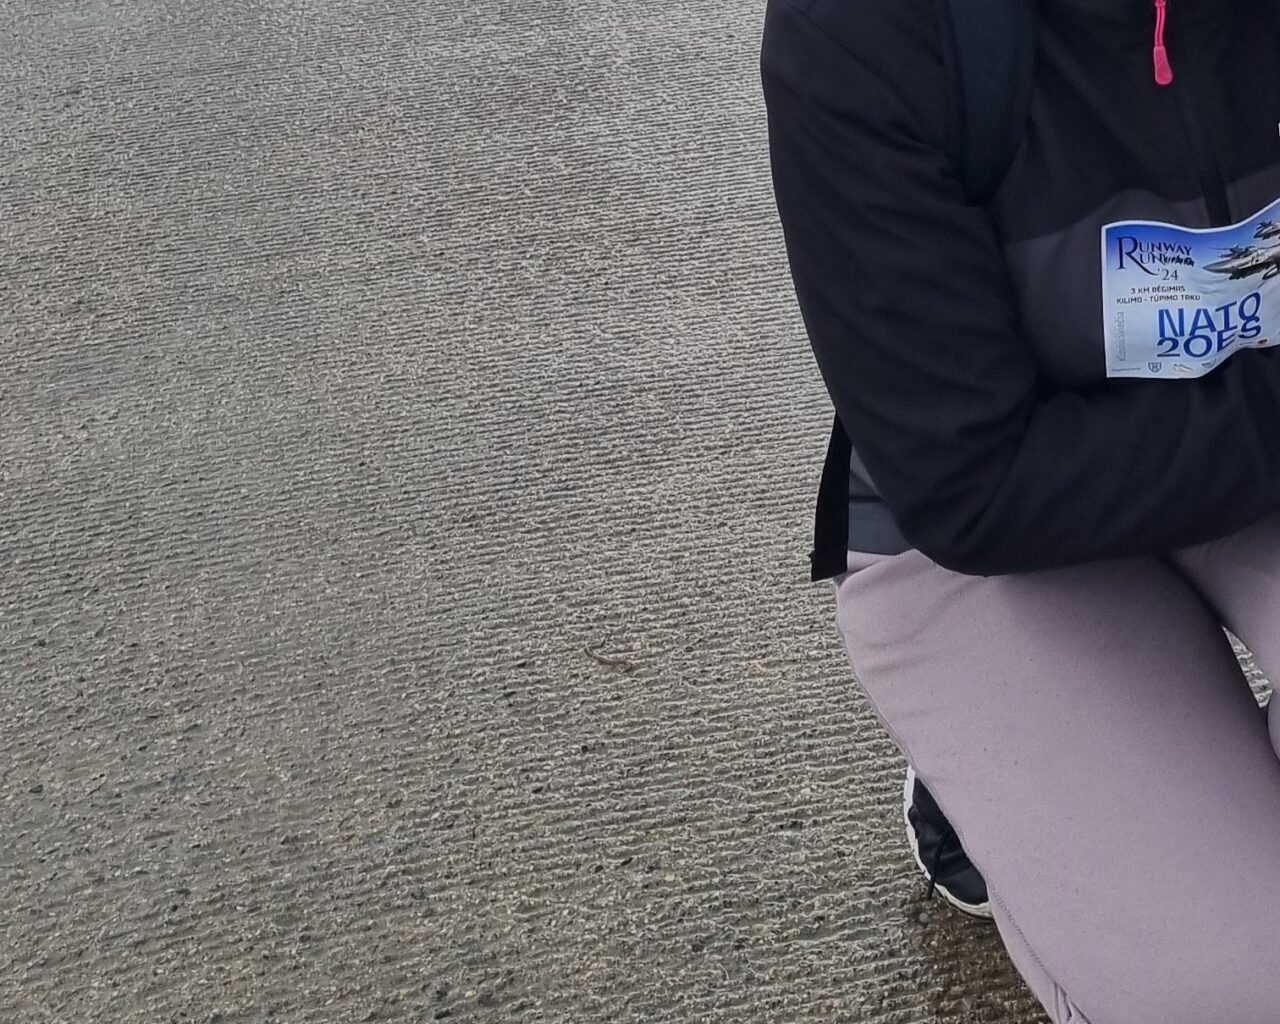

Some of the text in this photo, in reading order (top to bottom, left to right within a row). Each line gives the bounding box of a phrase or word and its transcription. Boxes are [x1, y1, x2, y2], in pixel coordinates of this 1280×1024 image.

[1117, 236, 1193, 270] RUNWAY
[1116, 296, 1143, 305] KILIMO
[1158, 292, 1262, 338] NATO
